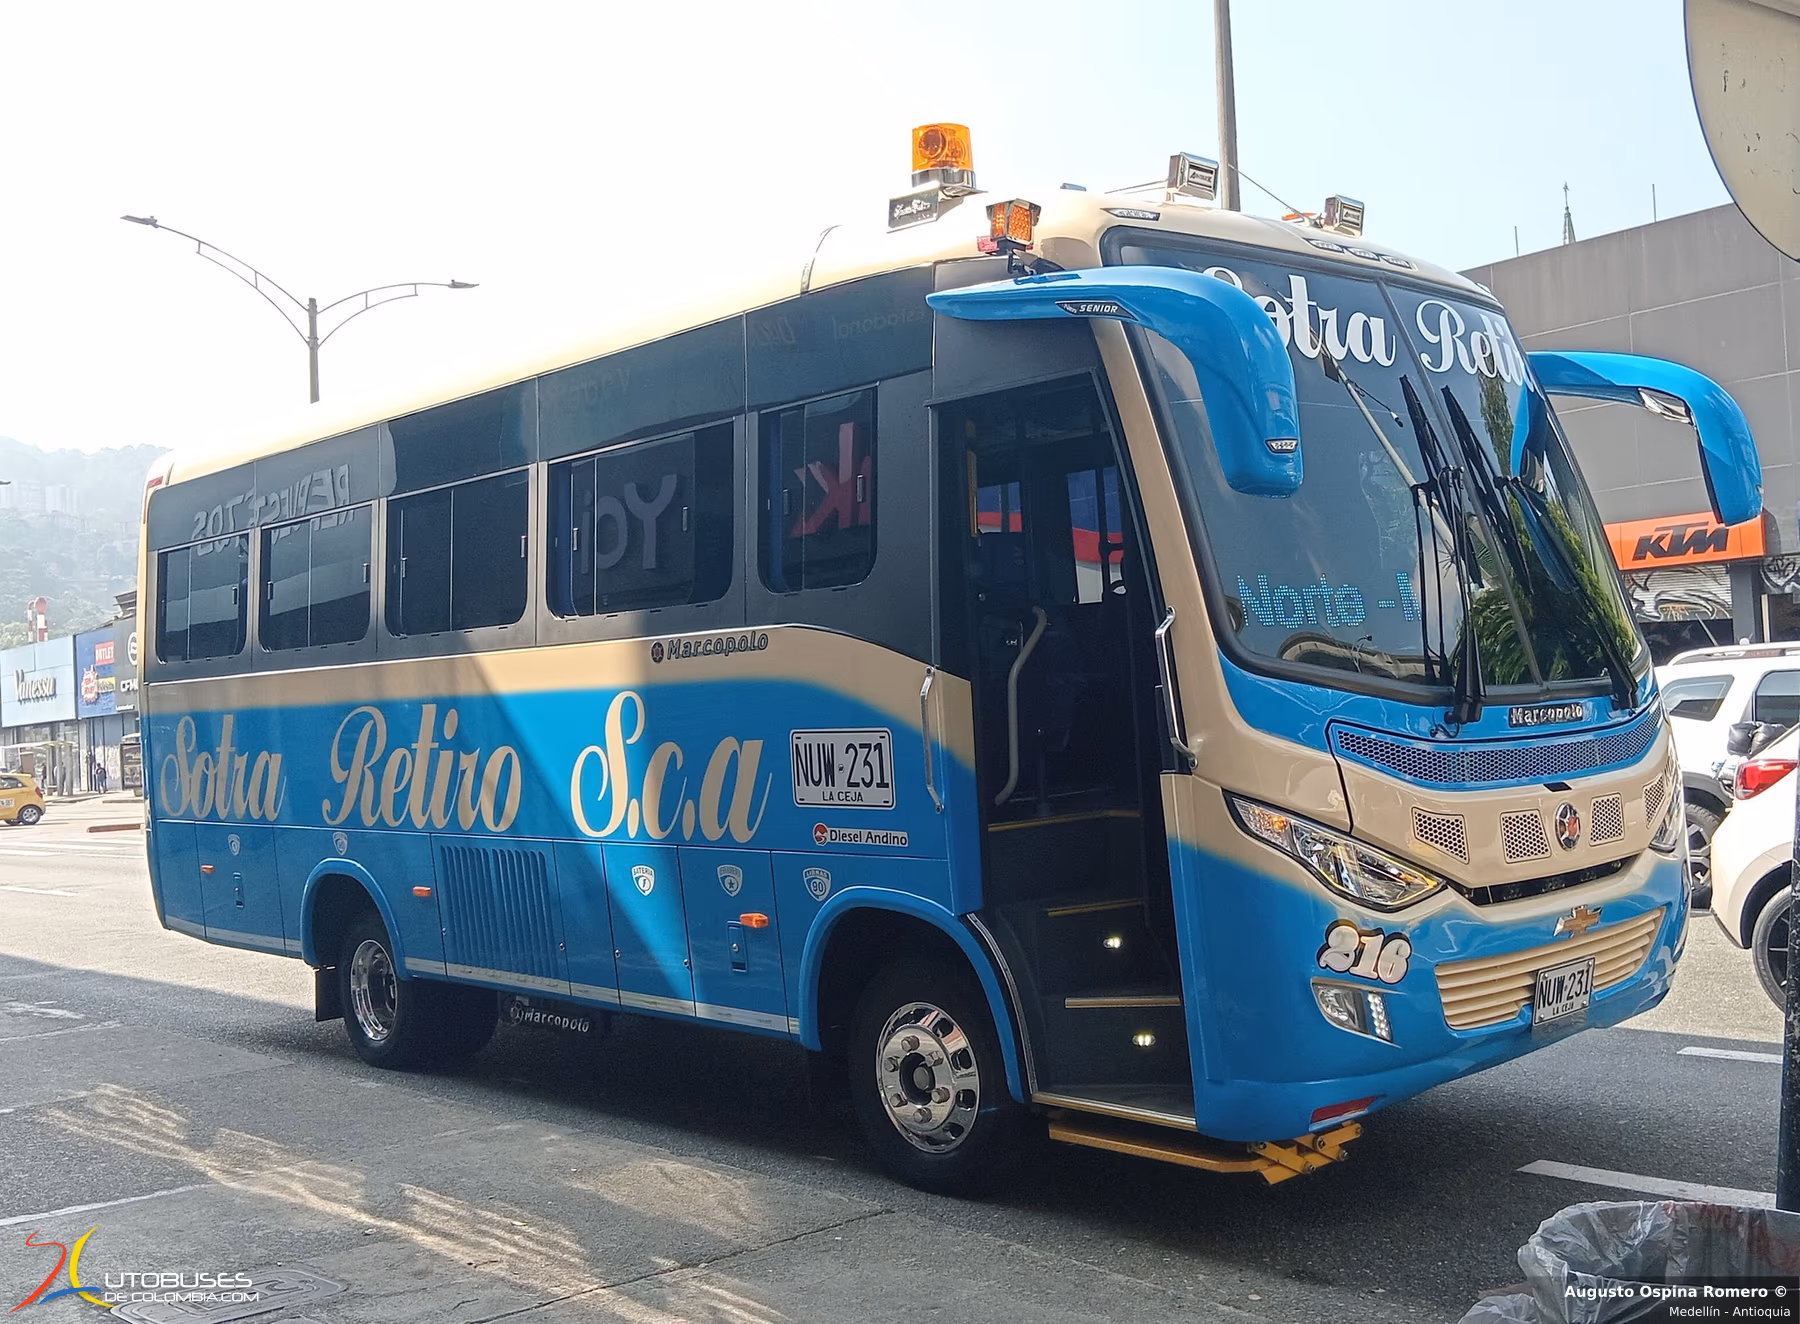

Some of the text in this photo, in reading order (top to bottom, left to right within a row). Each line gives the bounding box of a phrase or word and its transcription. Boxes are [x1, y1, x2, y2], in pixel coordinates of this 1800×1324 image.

[1080, 304, 1118, 313] SENIOR
[1203, 266, 1396, 367] otra
[1632, 521, 1730, 561] KTM
[1237, 573, 1366, 628] Norte
[667, 631, 769, 660] Marcopolo
[14, 669, 56, 702] Vanessa
[120, 679, 138, 693] CFM
[1511, 703, 1583, 726] Marcopolo
[161, 714, 286, 821] Sotra
[322, 704, 522, 832] Retiro
[822, 791, 864, 802] LA CEJA
[830, 830, 908, 846] Diesel Andino
[812, 881, 824, 892] 90
[1317, 919, 1412, 985] 216
[524, 1008, 590, 1033] Marcopolo
